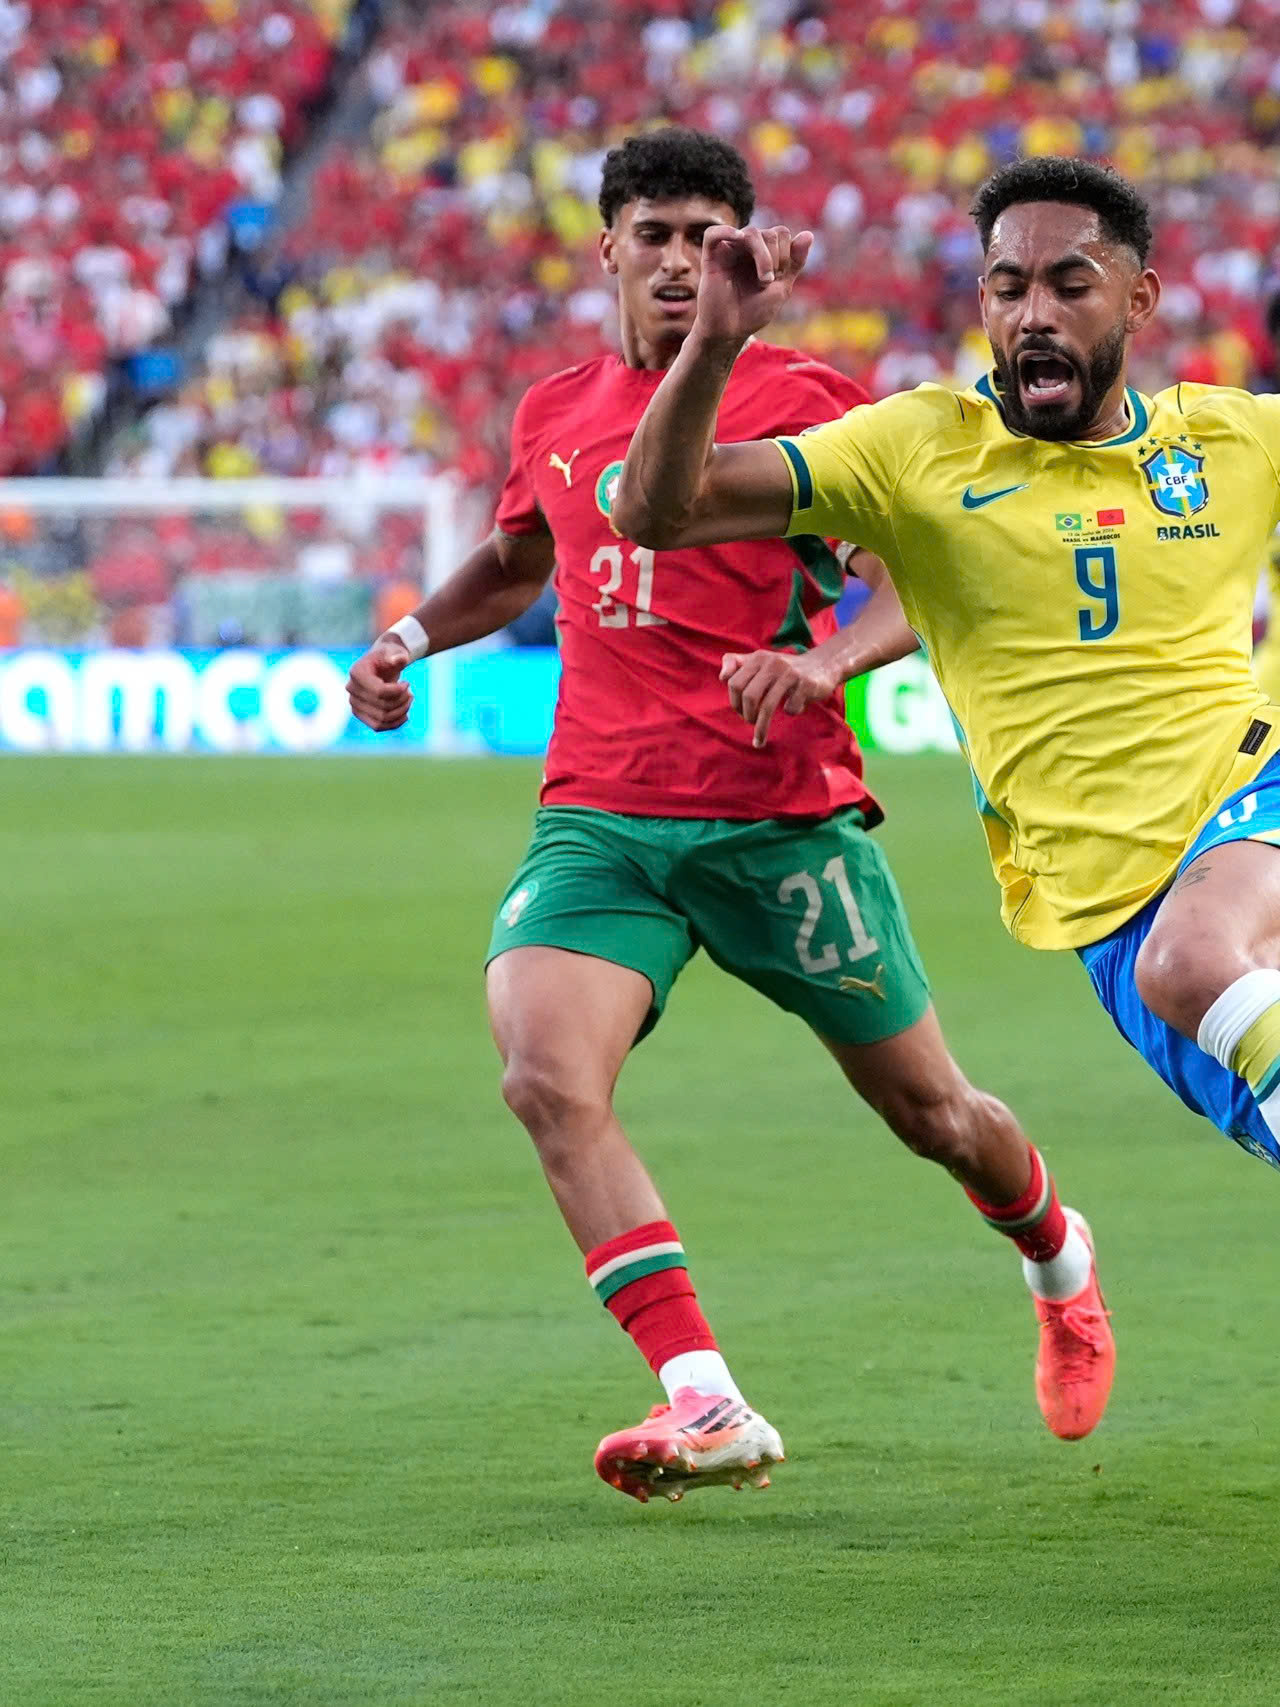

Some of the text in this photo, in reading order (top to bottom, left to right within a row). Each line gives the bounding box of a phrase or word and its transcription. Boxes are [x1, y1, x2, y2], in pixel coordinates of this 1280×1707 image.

[1165, 475, 1188, 485] CBF
[1157, 523, 1220, 540] BRASIL
[589, 545, 669, 628] 21
[1074, 546, 1119, 642] 9
[776, 855, 878, 974] 21
